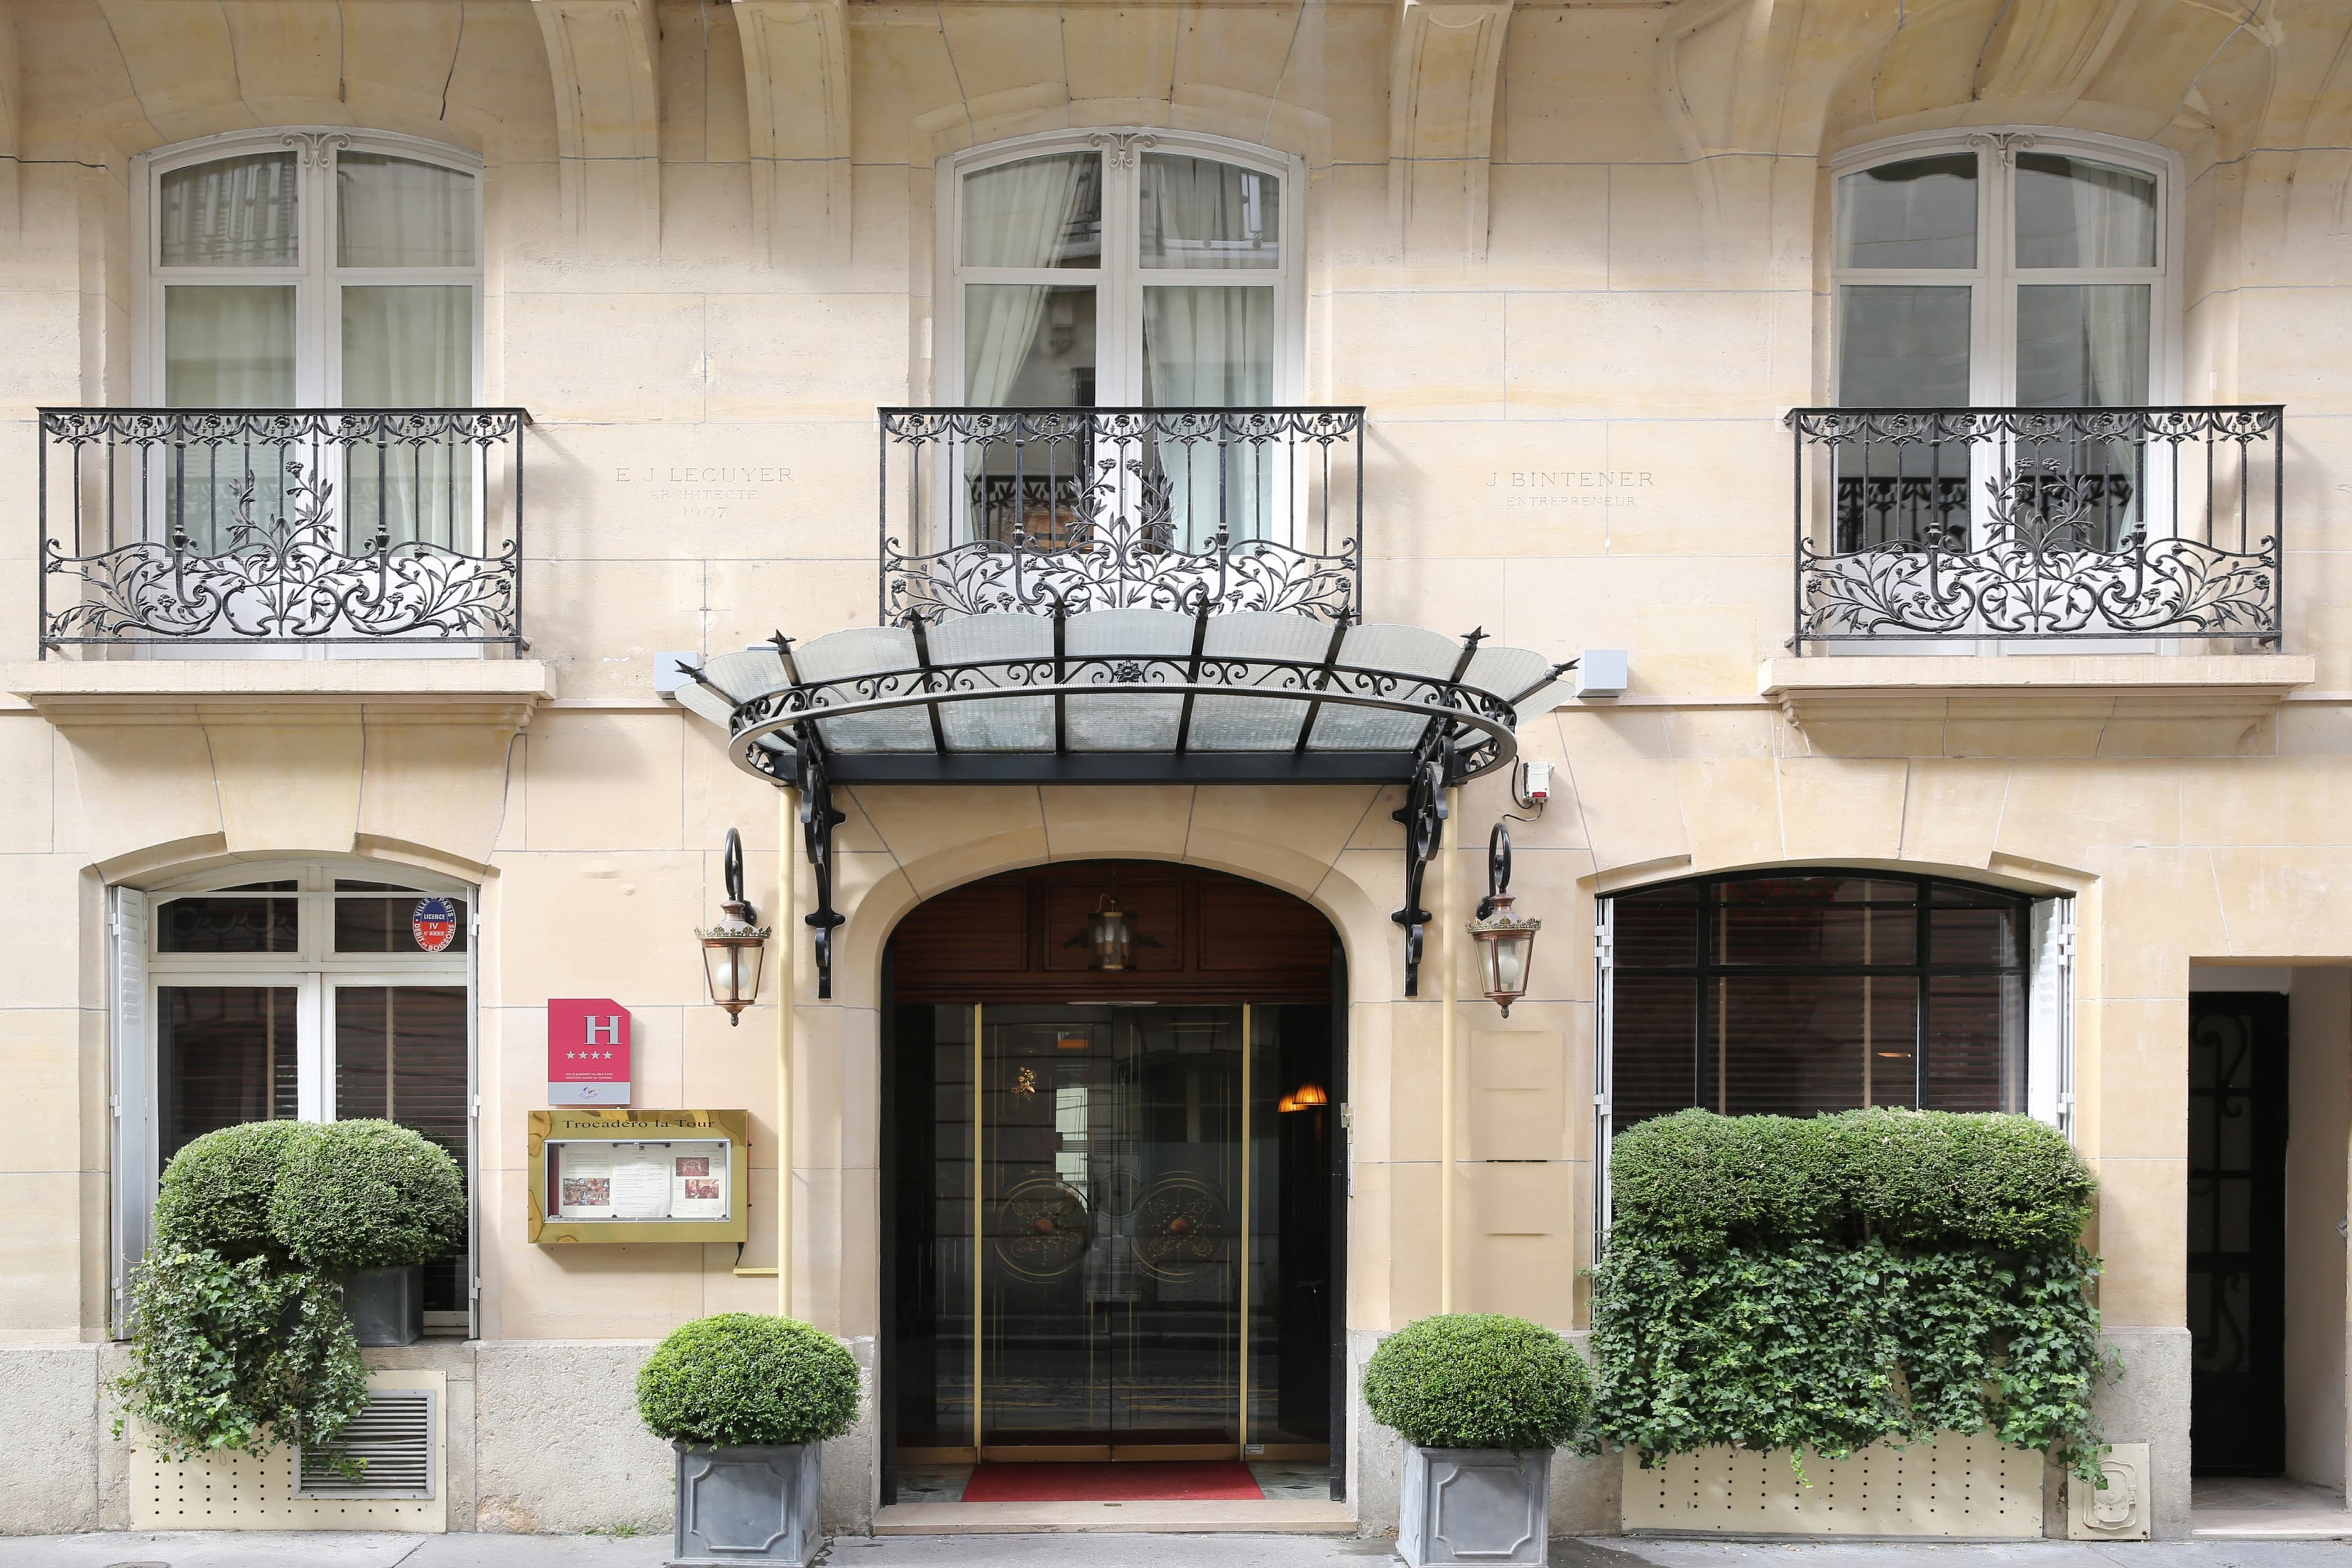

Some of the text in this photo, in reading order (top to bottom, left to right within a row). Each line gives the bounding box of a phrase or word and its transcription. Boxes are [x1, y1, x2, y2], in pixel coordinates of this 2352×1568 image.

[670, 468, 794, 482] LECUYER
[1512, 472, 1656, 487] BINTENER
[649, 490, 758, 500] ARCHITECTE
[1507, 497, 1637, 507] ENTREPRENEUR
[683, 507, 726, 518] 1907
[415, 897, 430, 916] VILLE
[438, 897, 454, 917] PARIS
[414, 923, 424, 942] DEBIT
[428, 924, 454, 951] BOISSONS
[583, 1015, 622, 1044] H
[562, 1120, 647, 1128] Trocadéro
[675, 1119, 715, 1128] Tour
